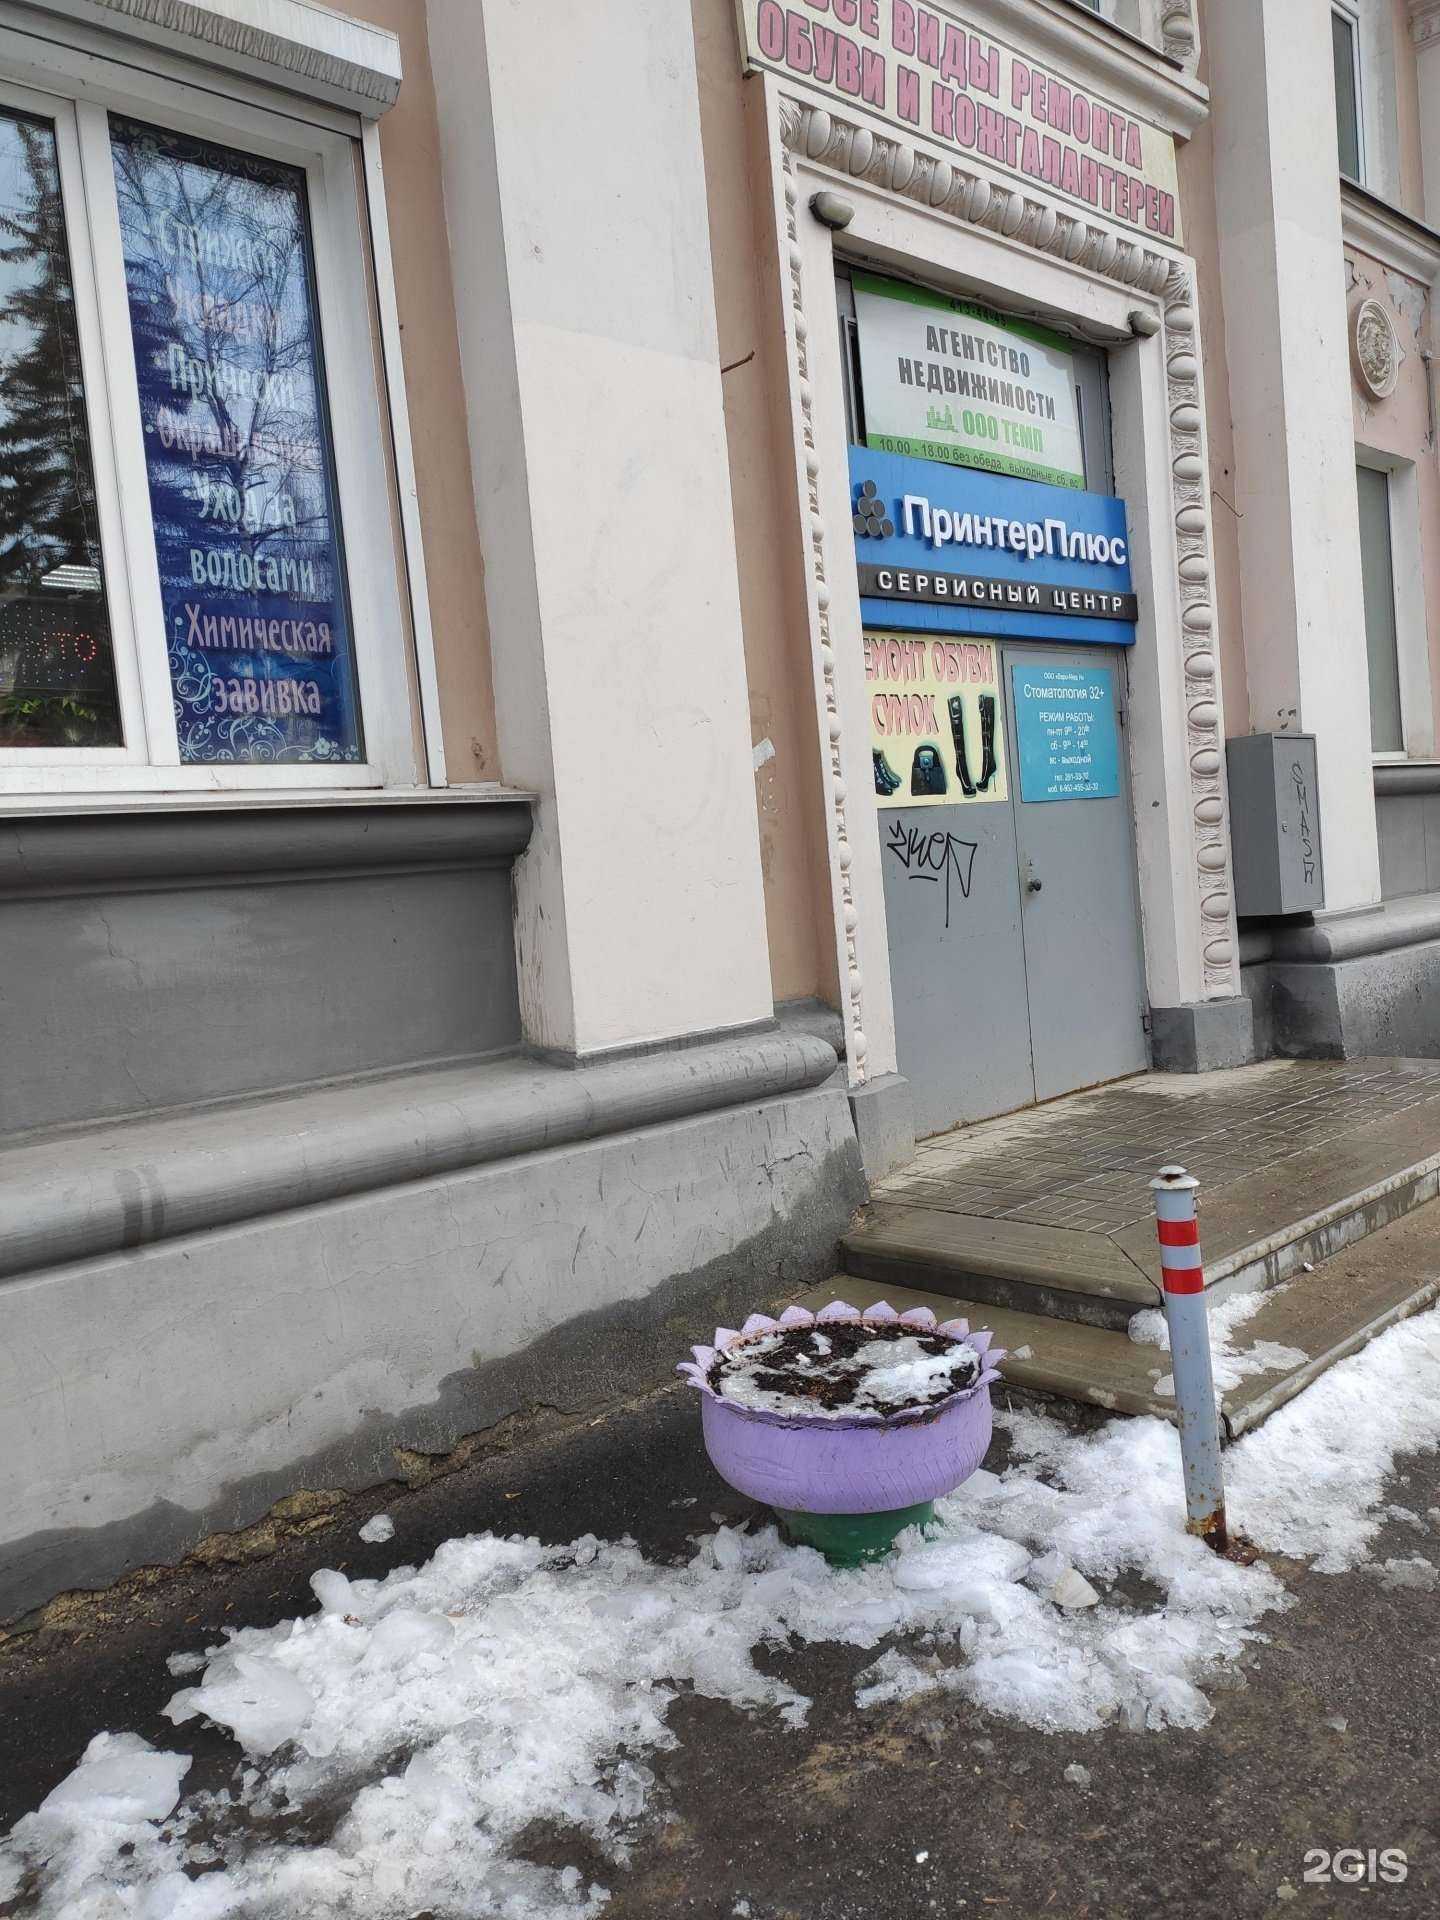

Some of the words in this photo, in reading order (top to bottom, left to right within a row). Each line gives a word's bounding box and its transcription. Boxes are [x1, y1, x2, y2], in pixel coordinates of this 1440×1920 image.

[757, 0, 885, 110] ОБУВИ
[897, 64, 920, 126] И
[892, 0, 1000, 98] ВИДЫ
[1011, 58, 1143, 170] РЕМОНТА
[926, 325, 1030, 378] АГЕНТСТВО
[898, 357, 1055, 421] НЕДВИЖИМОСТИ
[880, 438, 910, 455] 10.00
[922, 443, 949, 459] 18.00
[952, 448, 970, 462] без
[962, 409, 998, 441] ООО
[1000, 419, 1044, 453] ТЕМП
[903, 495, 1126, 565] ПринтерПлюс
[190, 549, 317, 595] волосами
[878, 570, 1040, 604] СЕРВИСНЫЙ
[1053, 589, 1123, 613] ЦЕНТР
[184, 603, 332, 653] Химическая
[931, 640, 994, 684] ОБУВИ
[214, 677, 321, 715] завивка
[1023, 683, 1087, 699] Стоматология
[1089, 686, 1105, 700] 32+
[872, 693, 939, 737] СУМОК
[1039, 711, 1064, 722] РЕЖИМ
